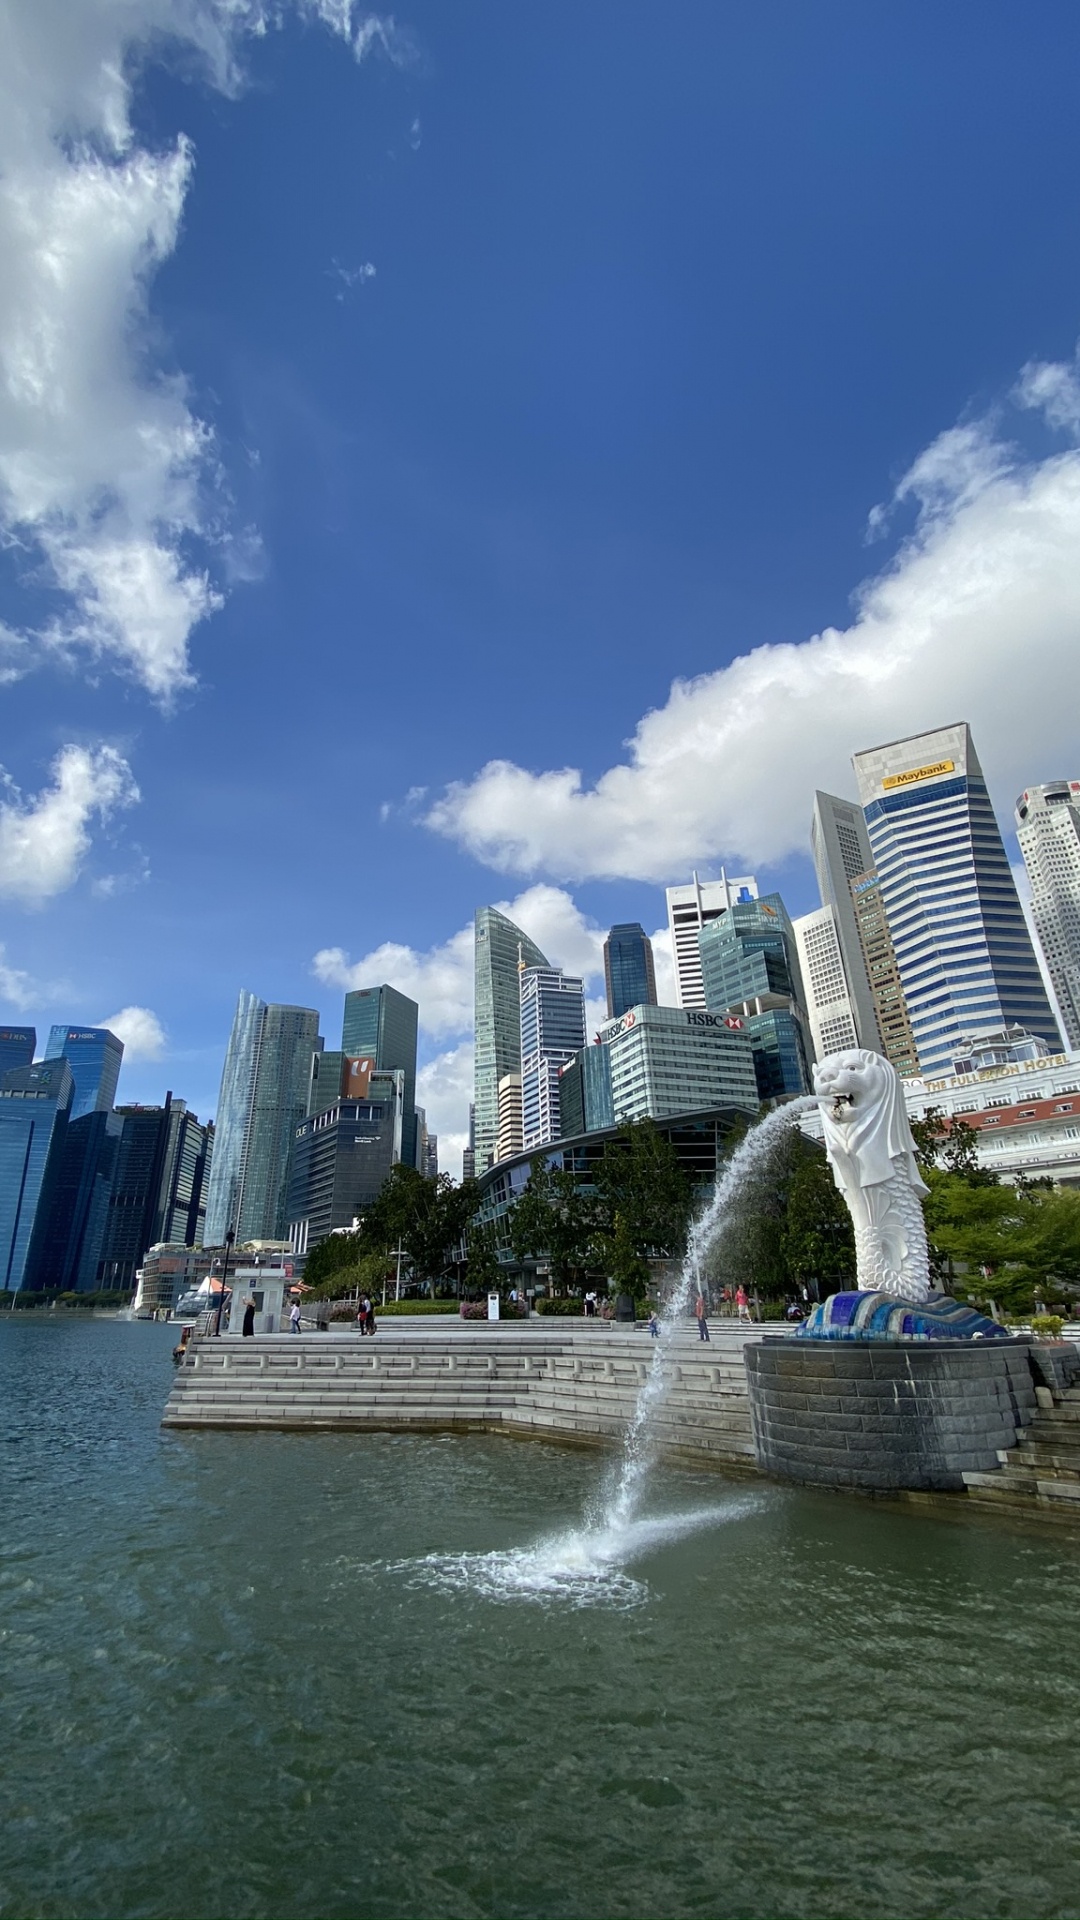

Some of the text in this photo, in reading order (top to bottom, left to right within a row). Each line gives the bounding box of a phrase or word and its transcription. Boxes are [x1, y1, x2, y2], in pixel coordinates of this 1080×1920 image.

[896, 764, 947, 783] Maybank
[712, 918, 727, 929] MYP
[686, 1012, 724, 1028] HSBC
[607, 1018, 626, 1040] HSBC
[924, 1080, 947, 1092] THE
[950, 1064, 1020, 1087] FULLERTON
[1024, 1054, 1070, 1071] HOTEL
[295, 1125, 308, 1138] OUE
